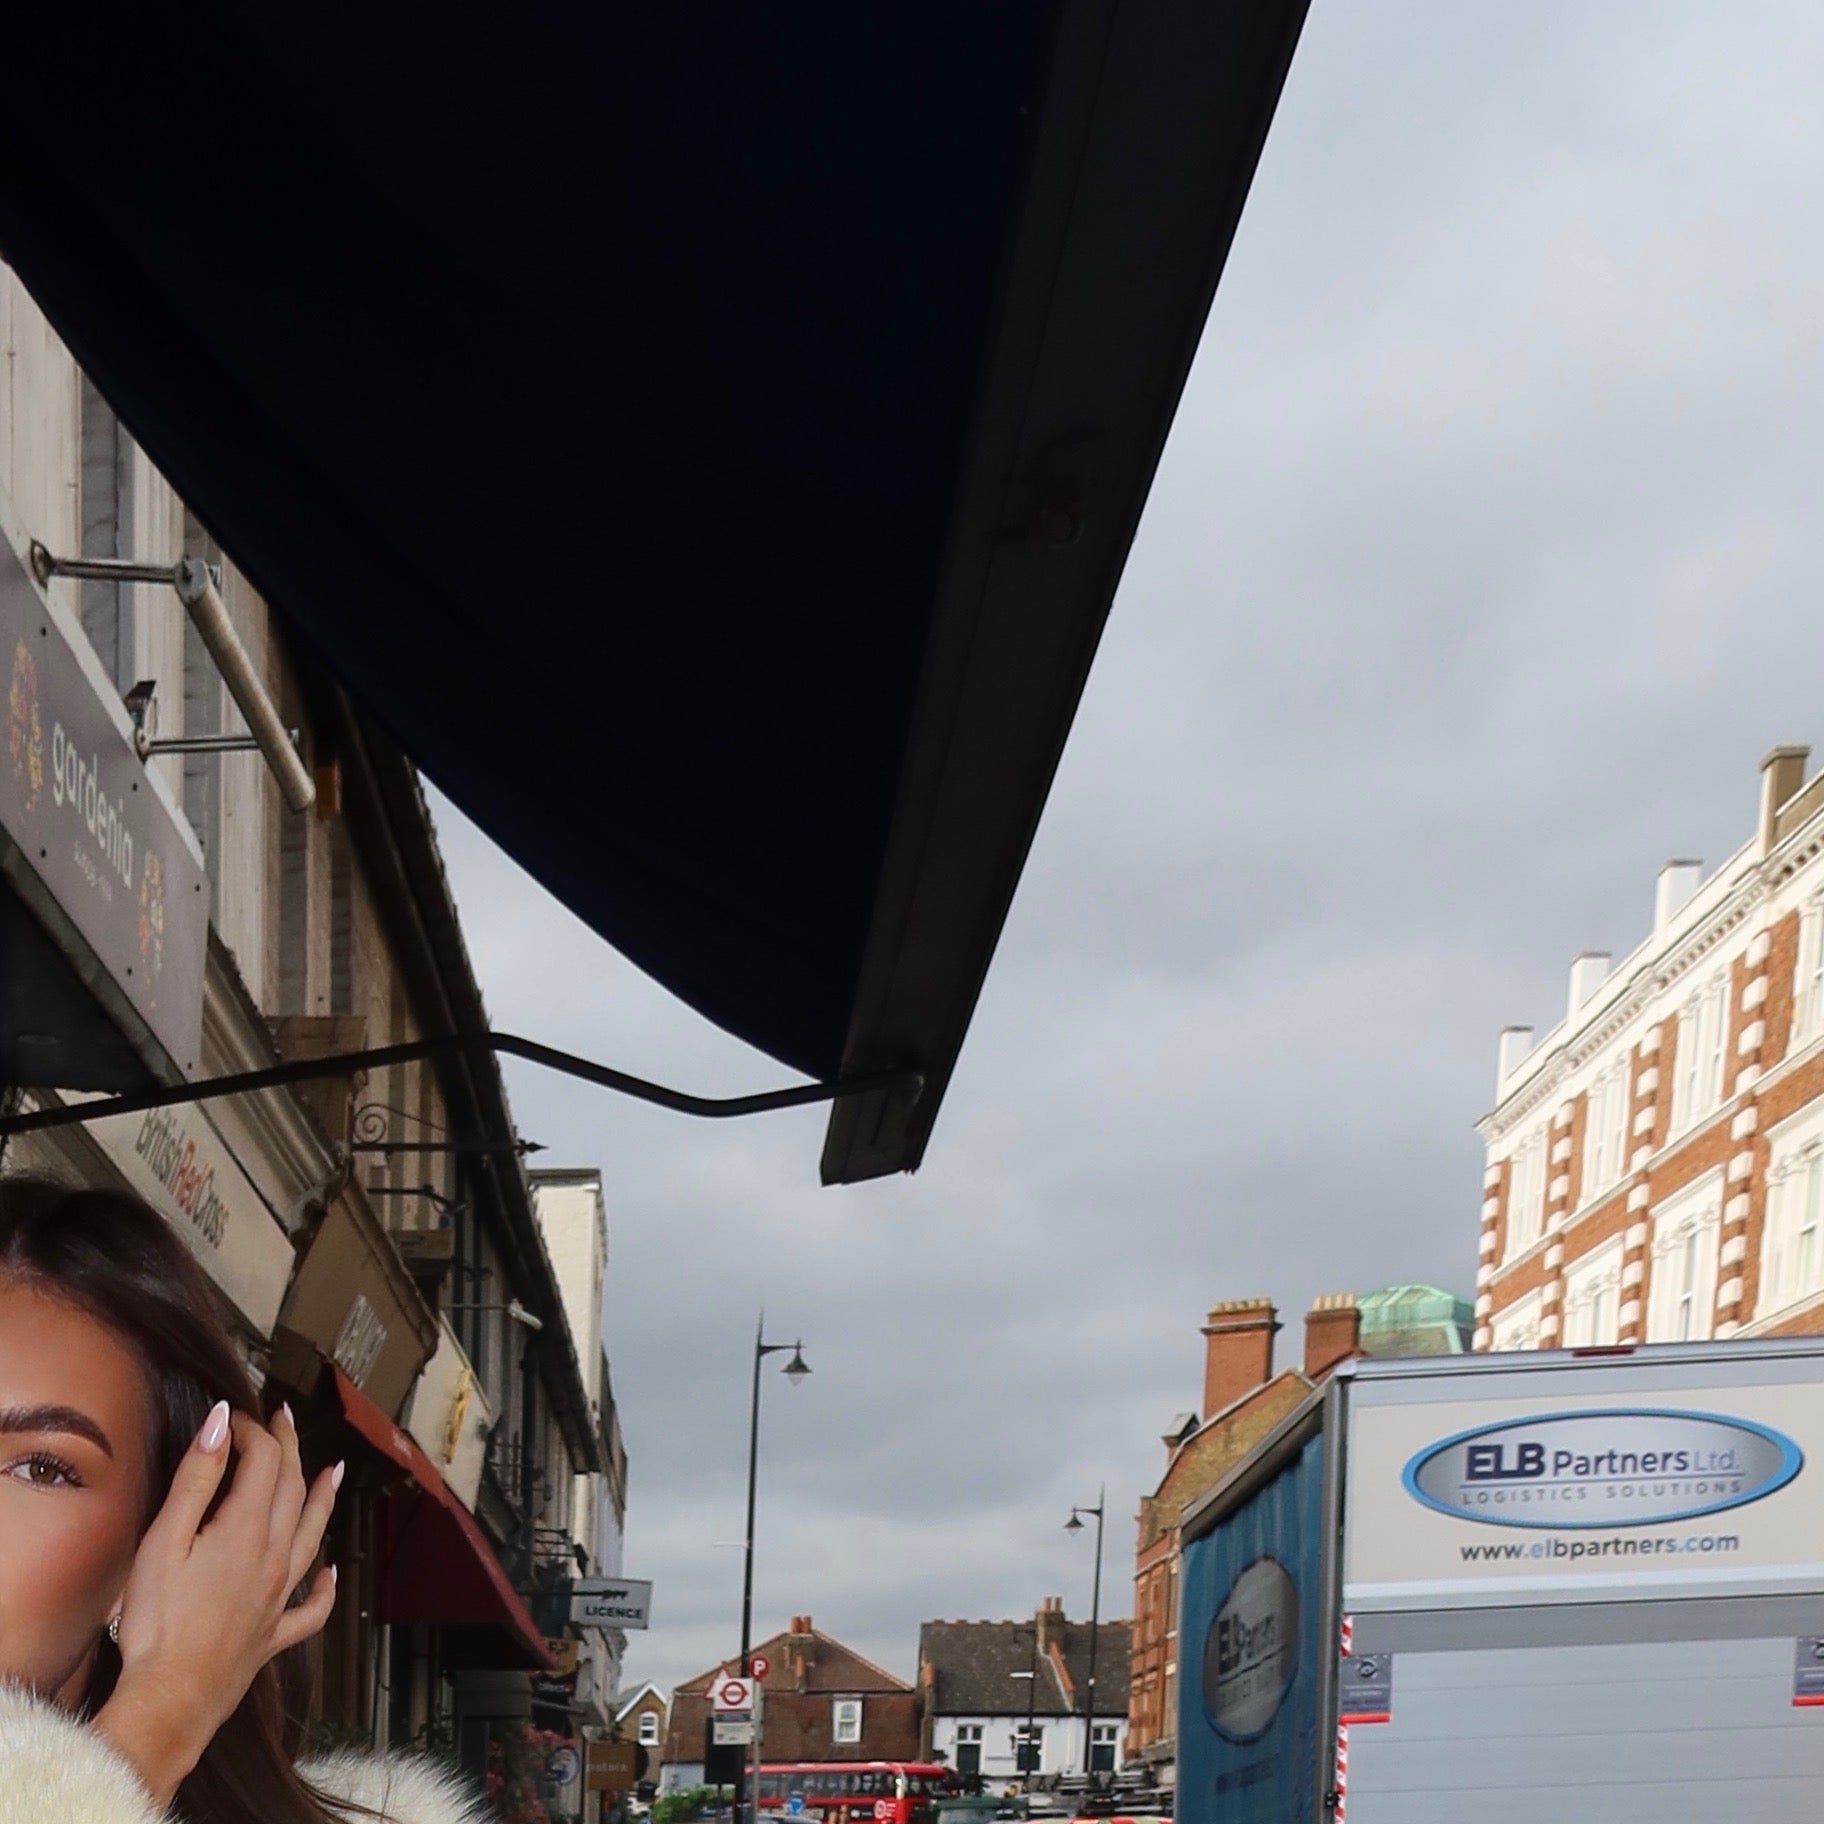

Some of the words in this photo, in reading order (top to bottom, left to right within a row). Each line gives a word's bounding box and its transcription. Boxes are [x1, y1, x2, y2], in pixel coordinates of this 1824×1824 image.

[52, 722, 133, 890] gardenia
[1465, 1443, 1546, 1480] ELB
[1553, 1448, 1689, 1477] Partners
[1693, 1447, 1741, 1472] Ltd.
[1461, 1486, 1588, 1505] LOGISTICS
[1606, 1480, 1742, 1498] SOLUTIONS
[1461, 1533, 1740, 1562] www.elbpartners.com
[585, 1606, 643, 1619] LICENCE
